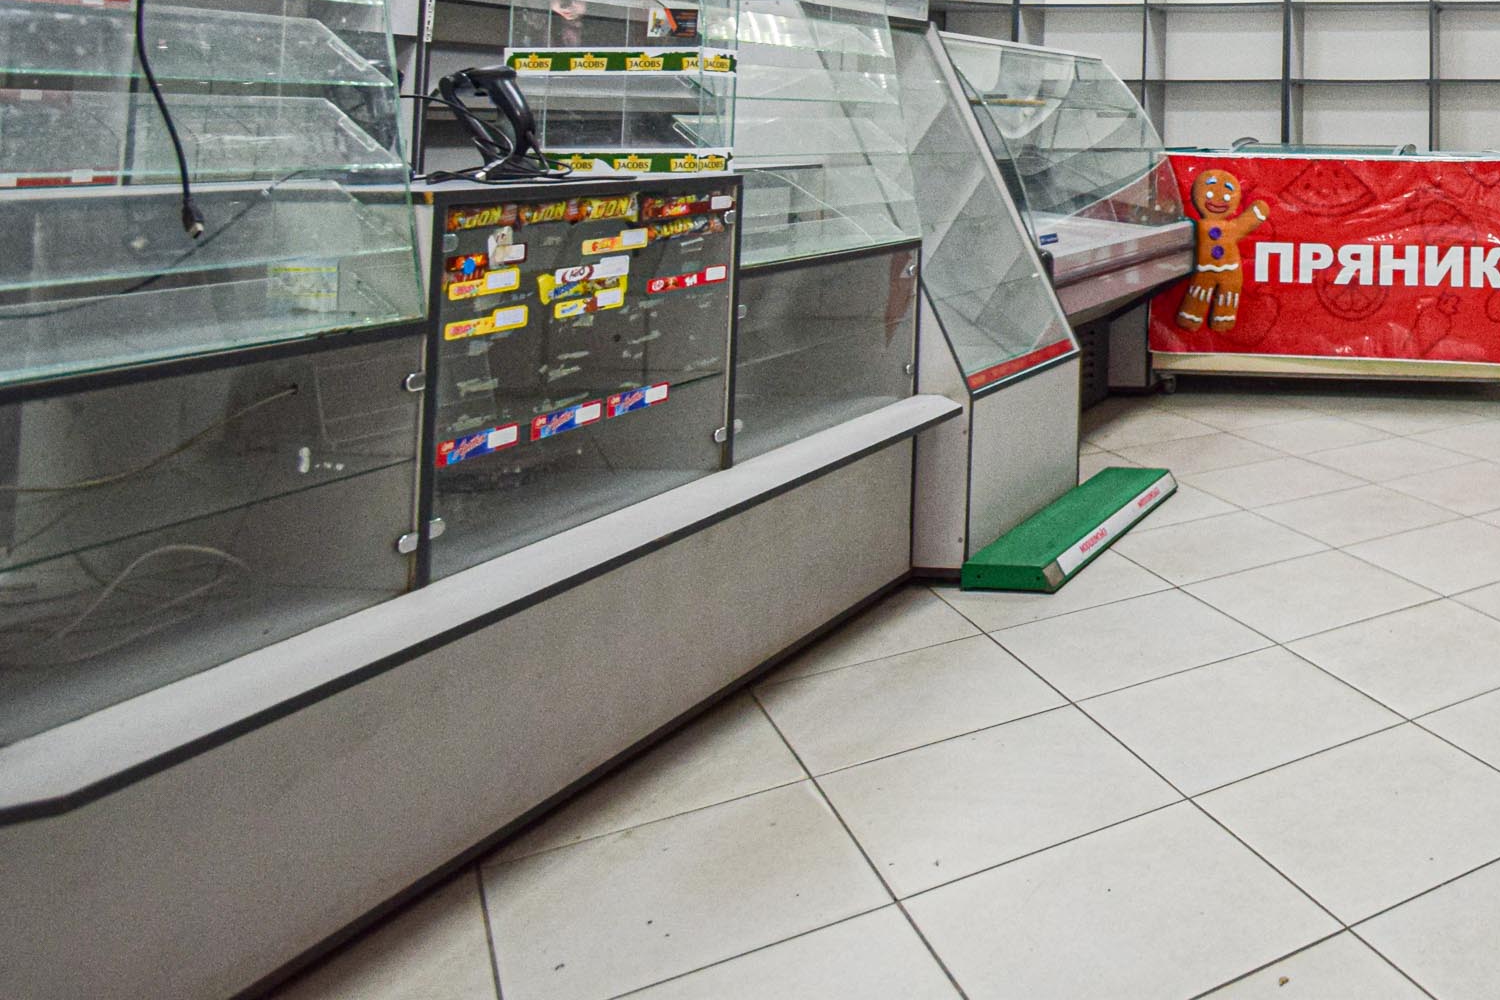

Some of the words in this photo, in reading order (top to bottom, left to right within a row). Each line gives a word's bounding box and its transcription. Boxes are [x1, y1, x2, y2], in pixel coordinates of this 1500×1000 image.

[519, 60, 549, 69] JACOBS
[574, 60, 604, 69] JACOBS
[630, 60, 661, 69] JACOBS
[705, 60, 728, 69] JACOBS
[617, 160, 649, 170] JACOBS
[701, 160, 724, 169] JACOBS
[532, 201, 567, 223] LION
[589, 197, 629, 220] LION
[464, 206, 502, 229] LION
